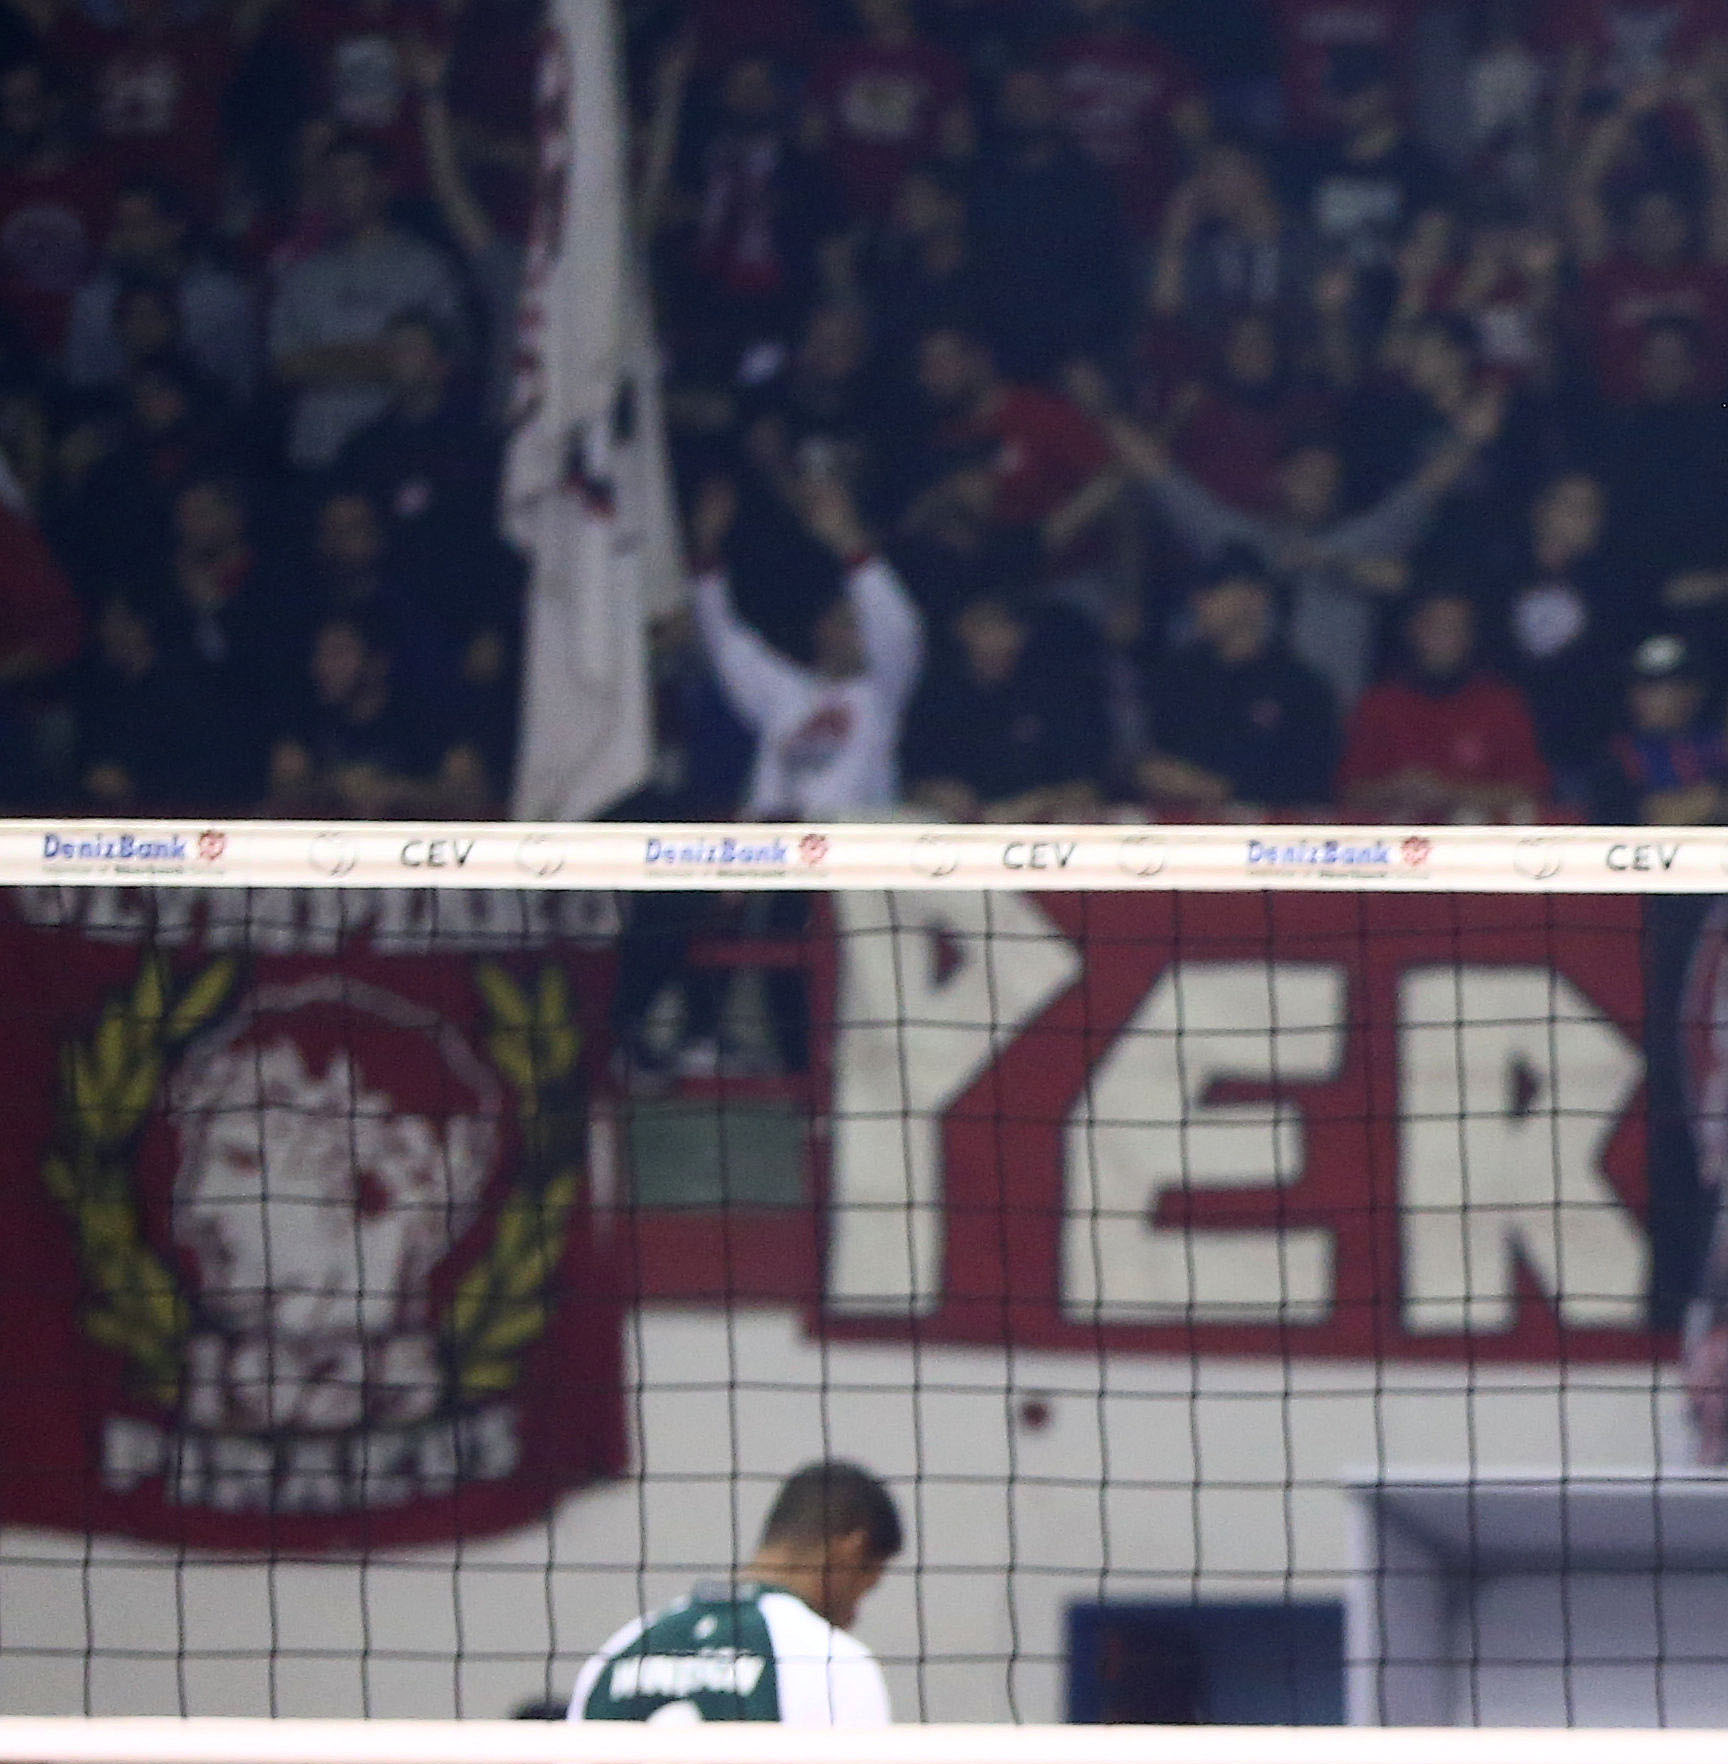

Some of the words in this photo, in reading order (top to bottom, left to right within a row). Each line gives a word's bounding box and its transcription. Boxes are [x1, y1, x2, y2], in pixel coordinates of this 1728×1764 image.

[44, 834, 187, 861] DenizBank
[399, 841, 474, 868] CEV
[647, 839, 788, 866] DenizBank
[1002, 844, 1076, 871] CEV
[1249, 840, 1390, 867] DenizBank
[1605, 845, 1679, 872] CEV
